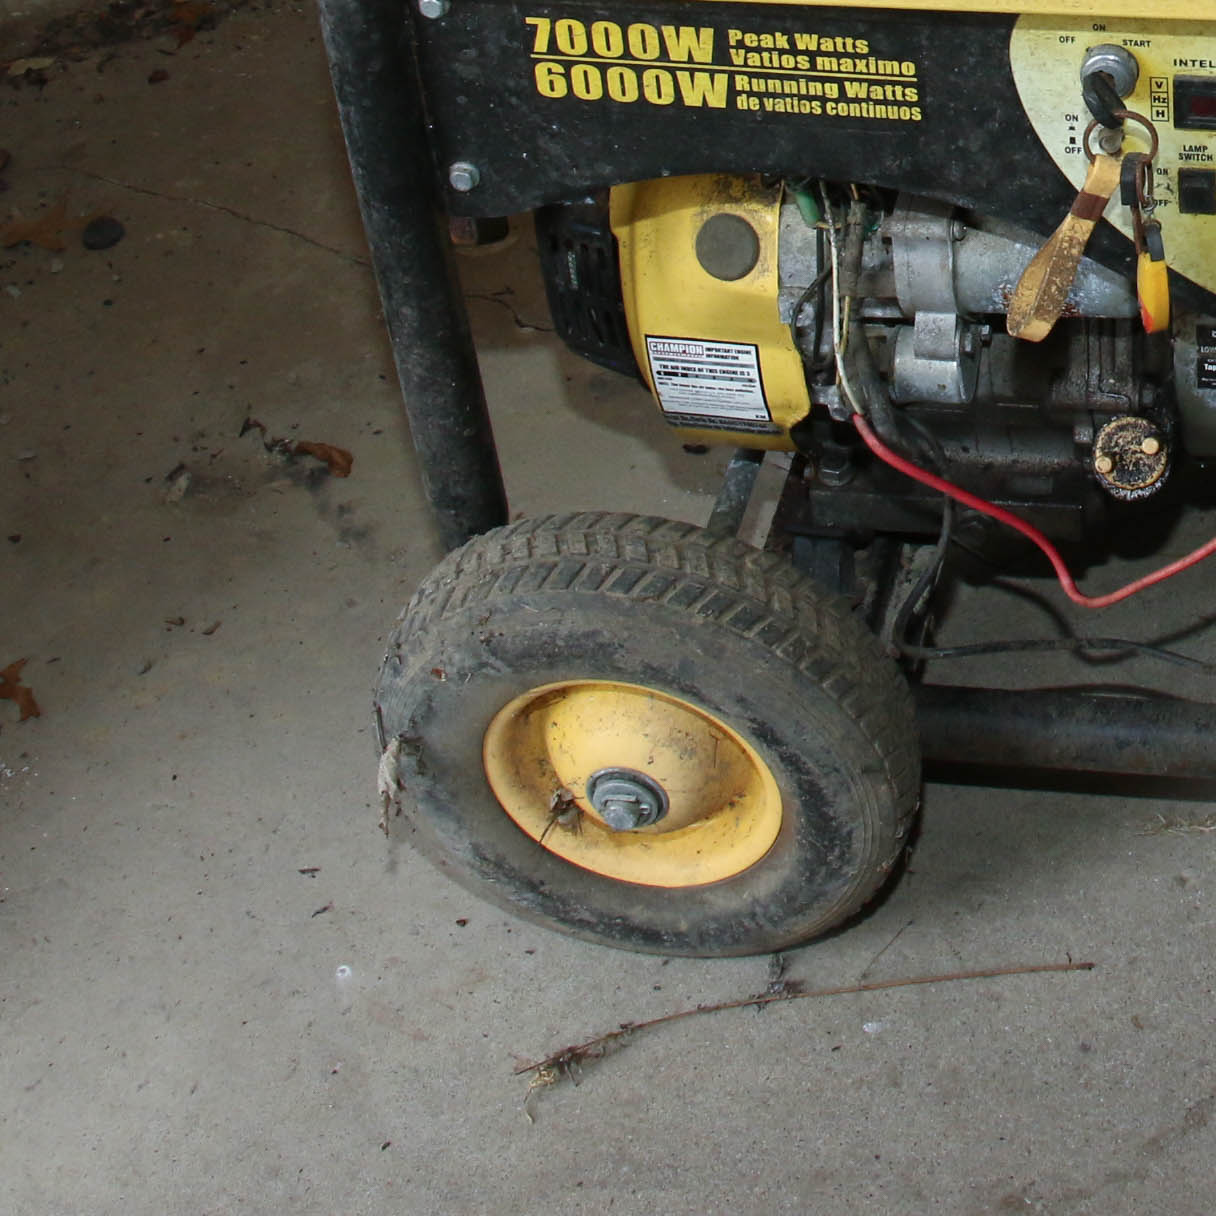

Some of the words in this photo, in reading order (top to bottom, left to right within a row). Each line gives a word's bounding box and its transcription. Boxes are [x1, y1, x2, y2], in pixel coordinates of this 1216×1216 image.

[1092, 24, 1106, 32] ON
[525, 16, 715, 64] 7000W
[728, 29, 790, 50] Peak
[794, 33, 870, 54] Watts
[1058, 36, 1076, 44] OFF
[1122, 39, 1152, 48] START
[729, 48, 811, 70] Vatios
[816, 56, 916, 76] maximo
[534, 61, 729, 109] 6000W
[735, 74, 839, 99] Running
[844, 81, 919, 102] Watts
[1154, 81, 1164, 89] V
[1152, 95, 1167, 104] Hz
[736, 94, 760, 111] de
[763, 96, 822, 115] vatios
[826, 100, 922, 121] continuos
[1064, 114, 1079, 123] ON
[1156, 110, 1165, 118] H
[1064, 146, 1083, 155] OFF
[1183, 145, 1209, 155] LAMP
[1178, 152, 1213, 163] SWITCH
[651, 342, 703, 355] CHAMPION
